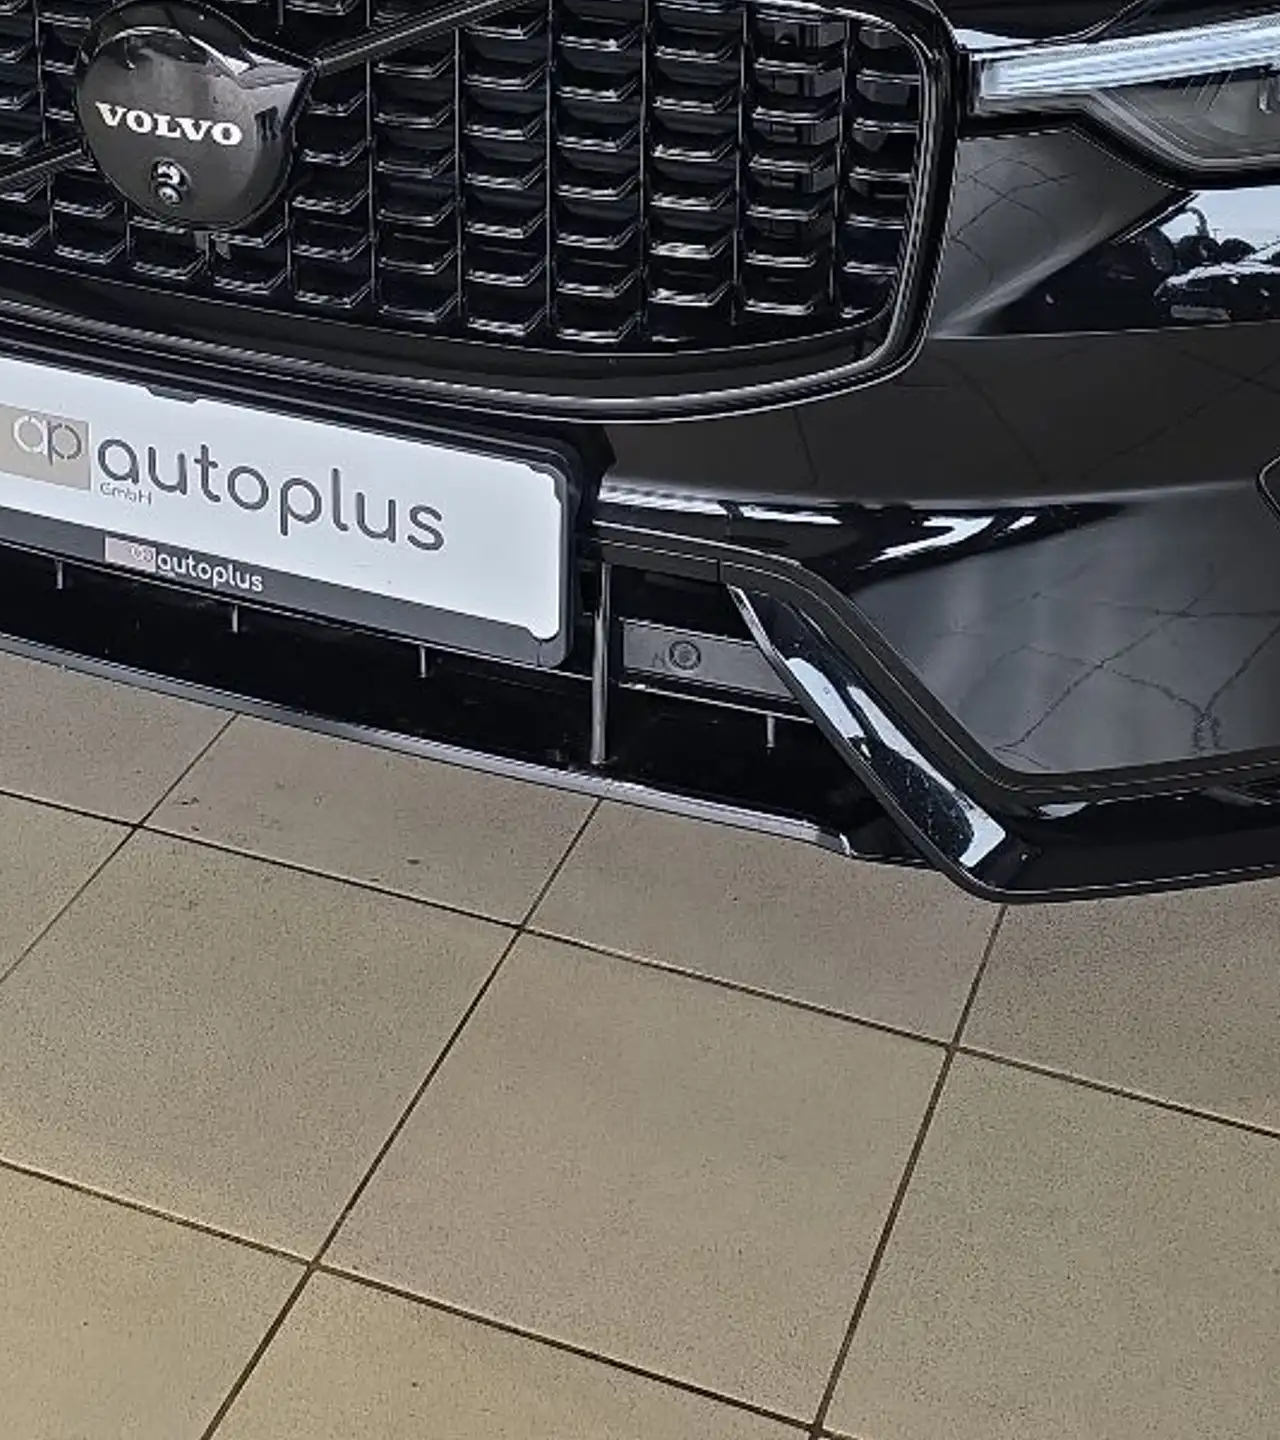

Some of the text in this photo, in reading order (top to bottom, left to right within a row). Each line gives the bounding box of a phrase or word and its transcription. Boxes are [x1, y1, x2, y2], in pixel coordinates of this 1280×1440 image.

[95, 101, 243, 146] VOLVO
[97, 437, 445, 551] autoplus
[100, 482, 152, 505] GmbH
[158, 554, 263, 592] autoplus
